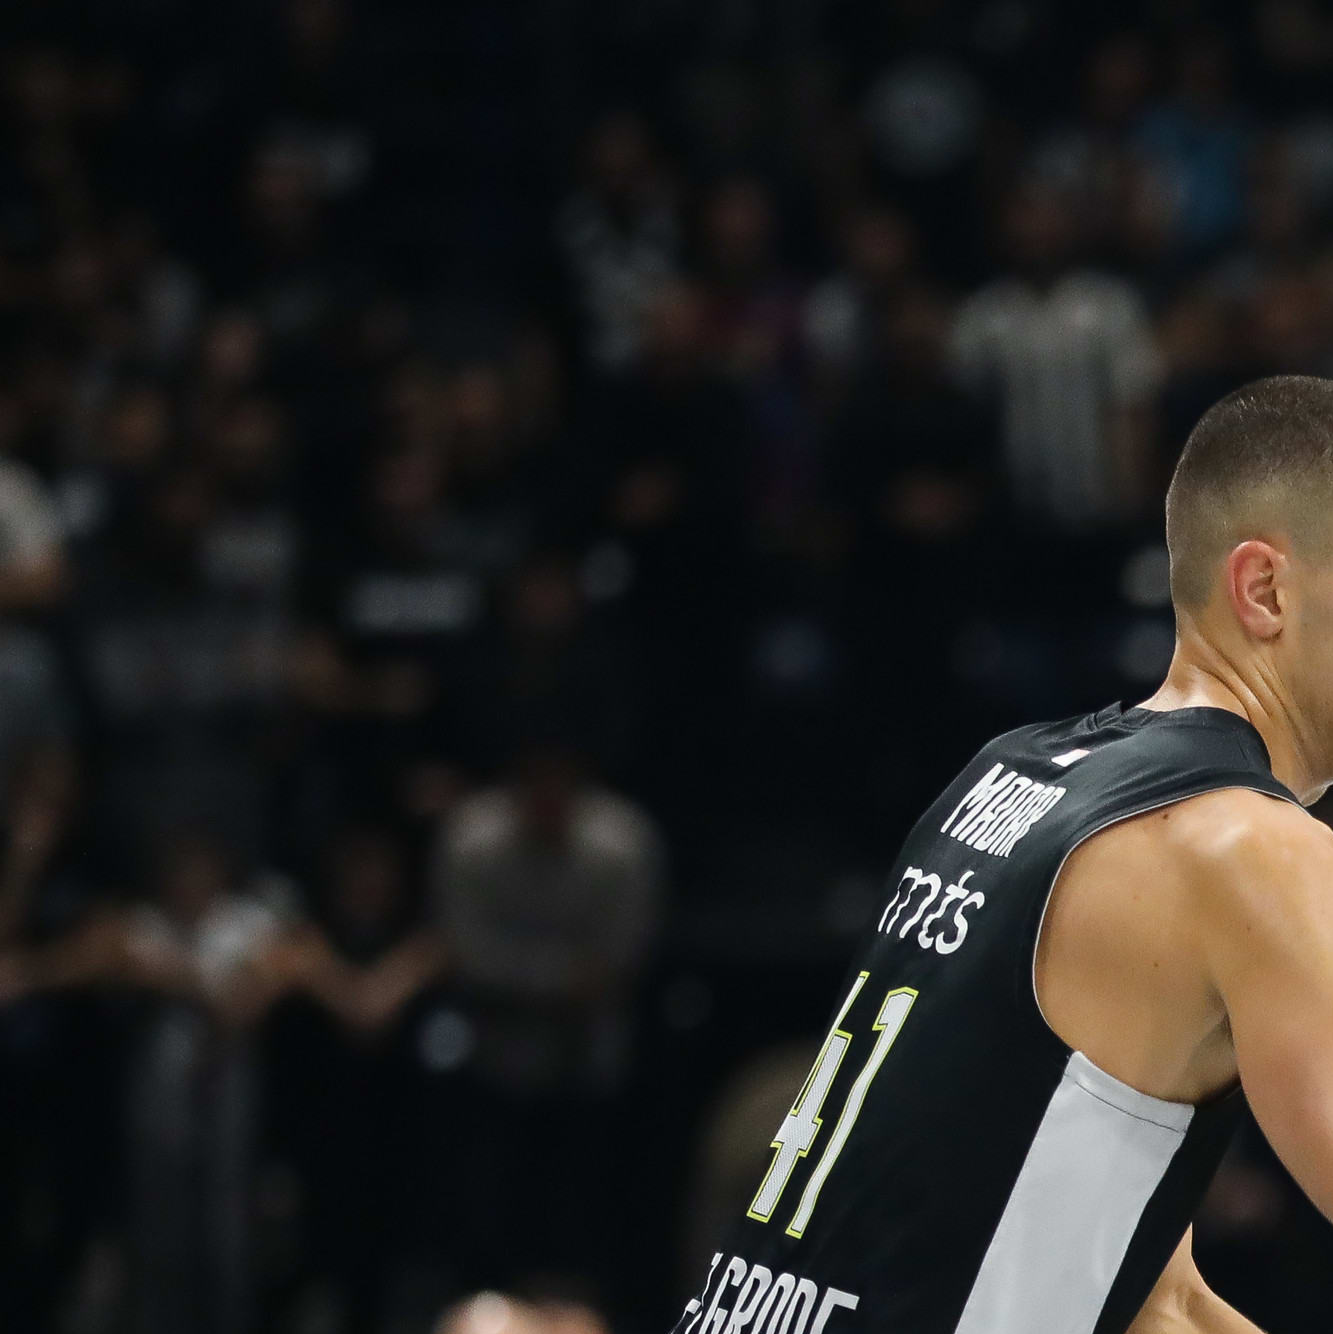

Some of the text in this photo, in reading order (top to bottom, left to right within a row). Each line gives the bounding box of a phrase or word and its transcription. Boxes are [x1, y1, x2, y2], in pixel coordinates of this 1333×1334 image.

[940, 762, 1067, 858] MADAR
[877, 866, 985, 955] mts
[746, 971, 919, 1240] 41
